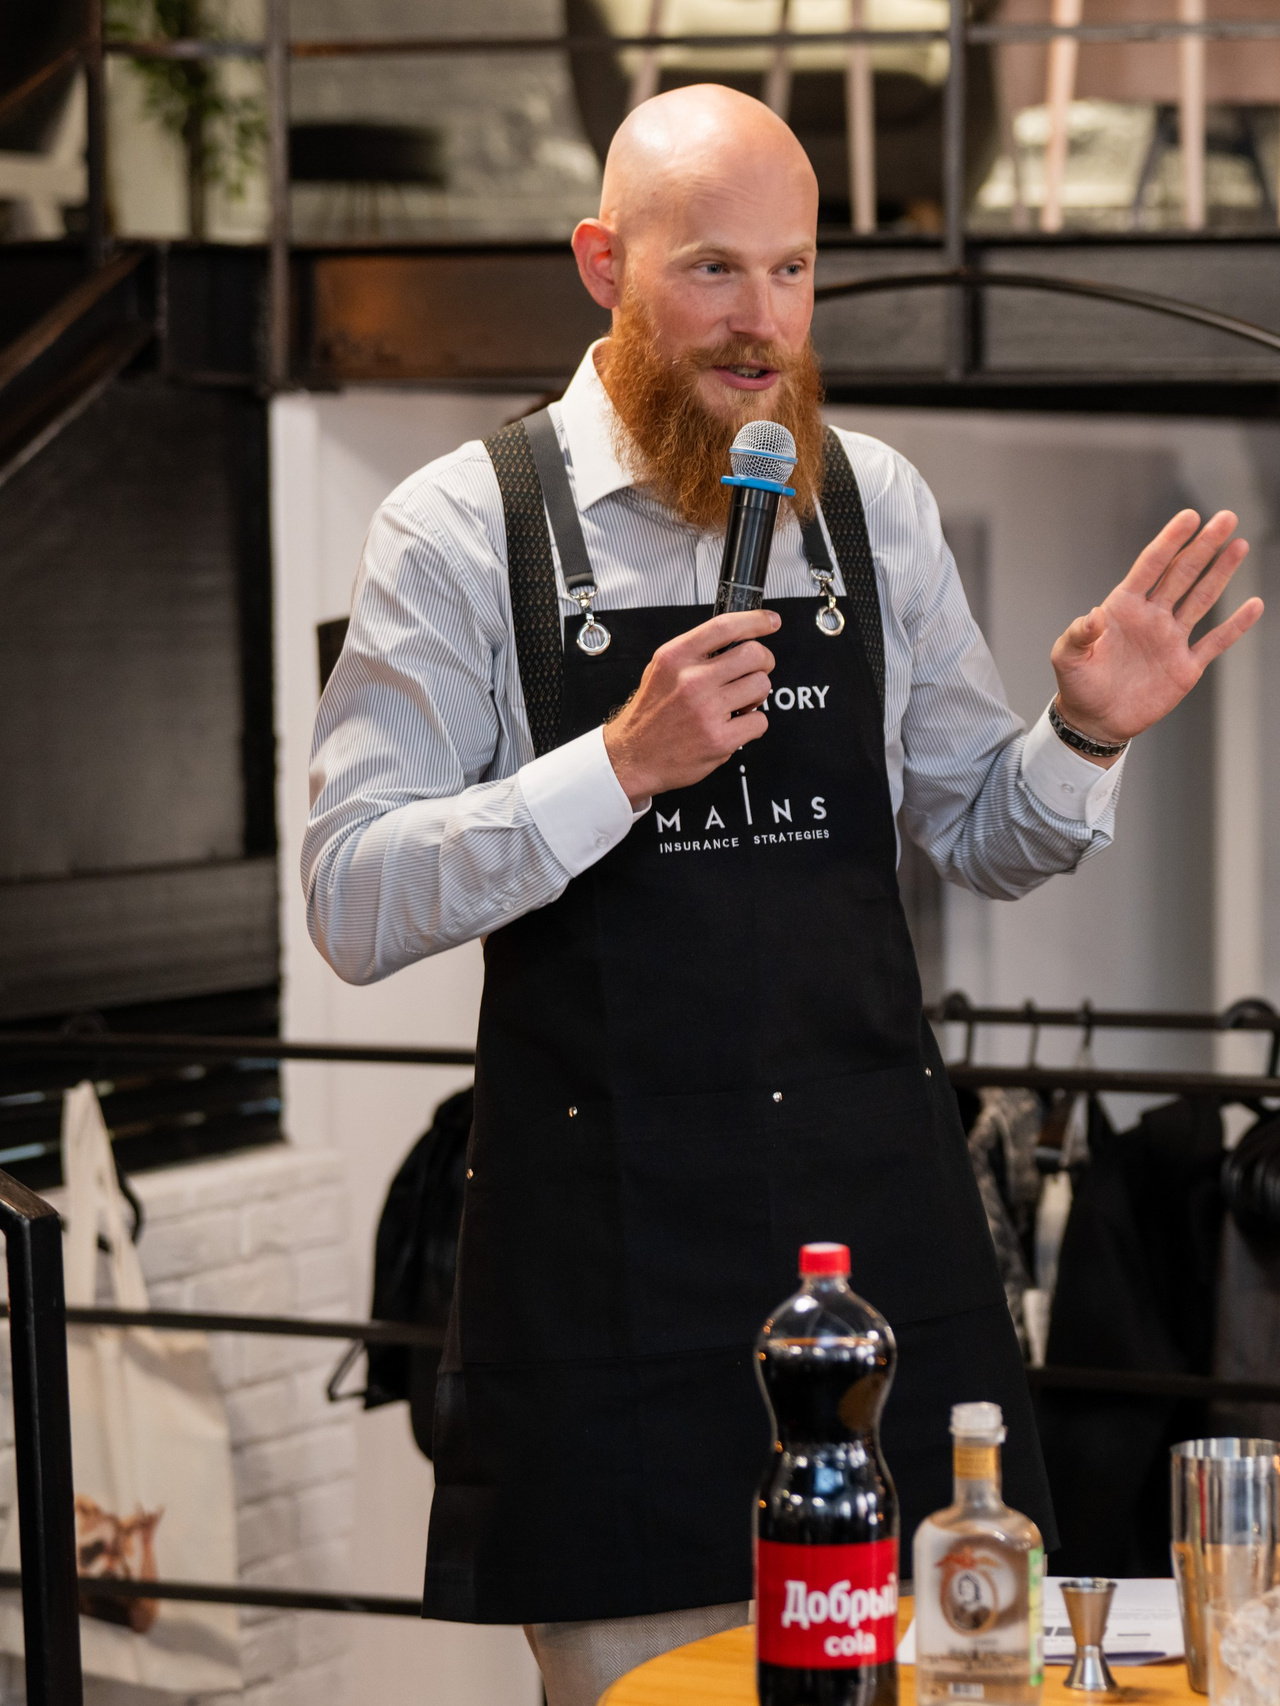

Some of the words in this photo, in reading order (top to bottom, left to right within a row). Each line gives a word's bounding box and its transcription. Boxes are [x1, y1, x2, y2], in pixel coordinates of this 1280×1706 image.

[659, 837, 740, 854] INSURANCE
[753, 829, 830, 845] STRATEGIES
[823, 1629, 877, 1657] cola
